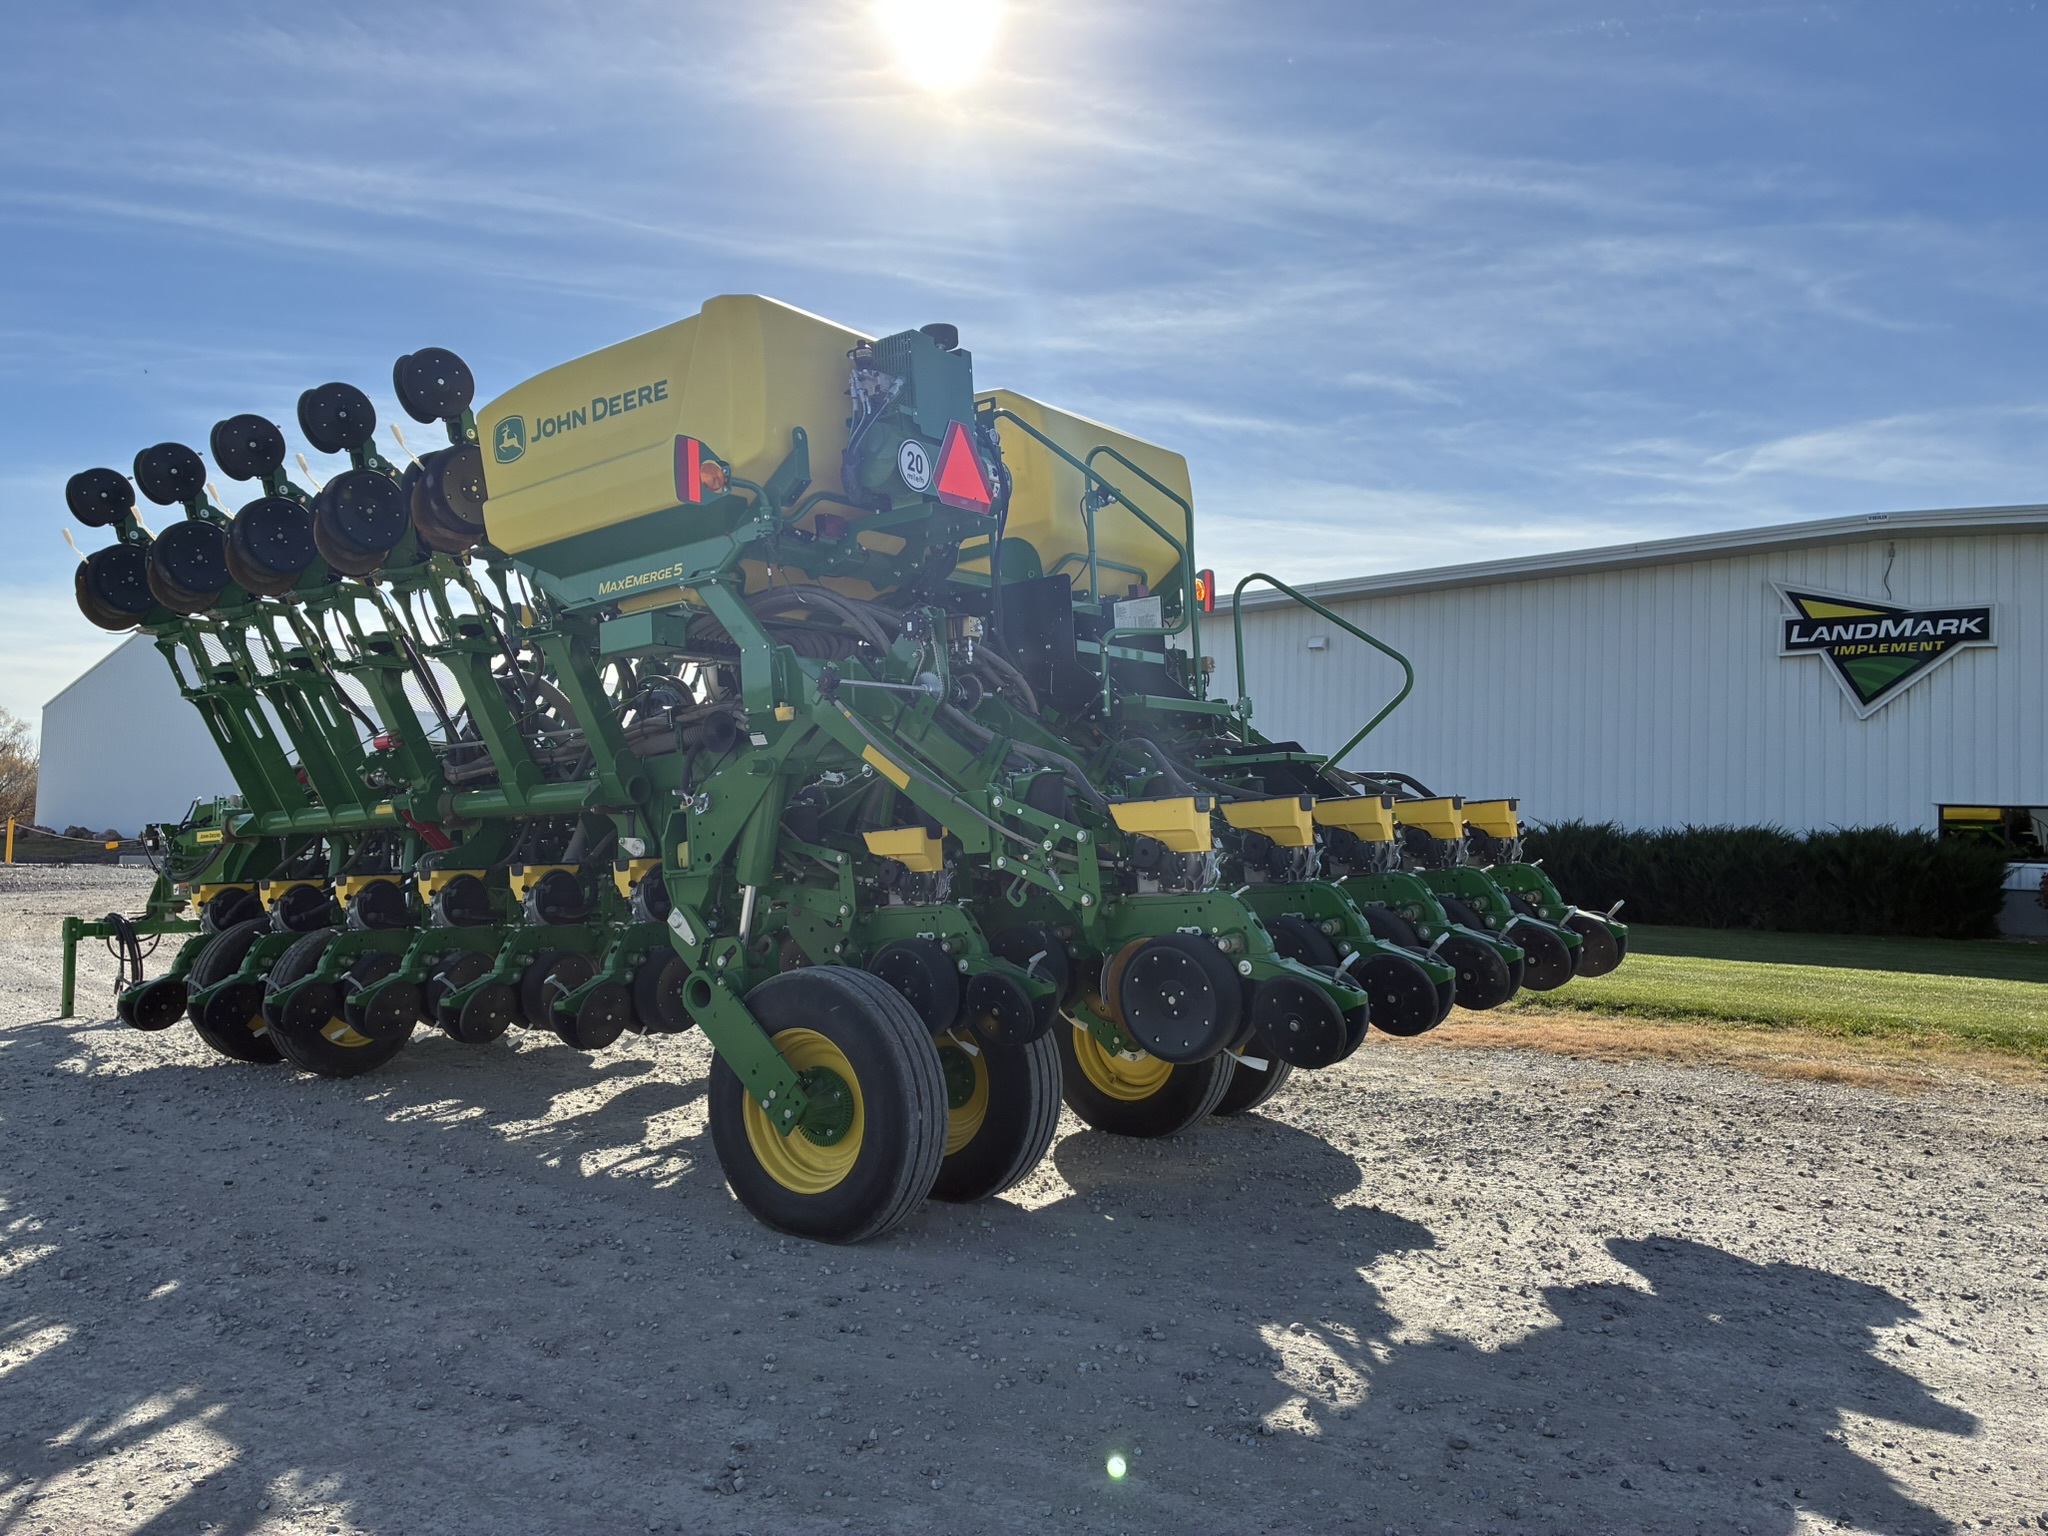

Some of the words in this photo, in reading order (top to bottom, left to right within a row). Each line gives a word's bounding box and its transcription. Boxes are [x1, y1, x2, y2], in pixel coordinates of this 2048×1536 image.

[531, 406, 587, 443] JOHN
[592, 379, 669, 422] DEERE
[907, 451, 923, 474] 20
[1790, 617, 1985, 643] LANDMARK
[1833, 640, 1945, 656] IMPLEMENT
